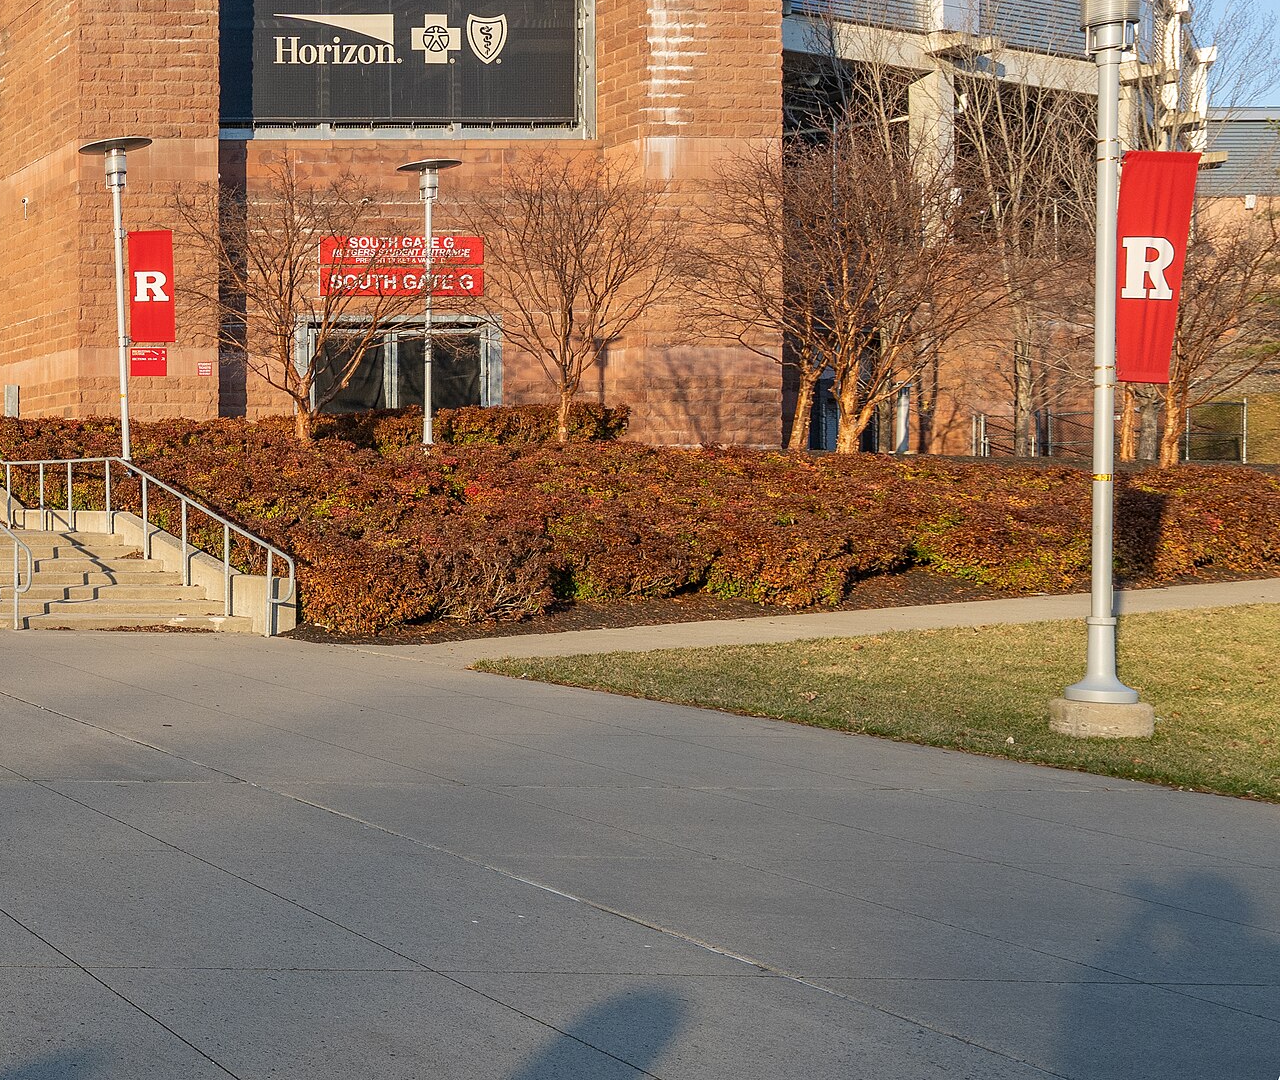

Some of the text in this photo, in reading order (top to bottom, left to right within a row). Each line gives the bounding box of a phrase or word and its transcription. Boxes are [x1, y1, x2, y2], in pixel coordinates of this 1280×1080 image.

[273, 36, 397, 65] Horizon
[349, 237, 397, 249] SOUTH
[443, 237, 455, 249] G
[355, 257, 385, 265] PRENT
[1121, 236, 1174, 300] R
[133, 270, 170, 302] R
[330, 274, 397, 290] SOUTH
[460, 274, 474, 290] G
